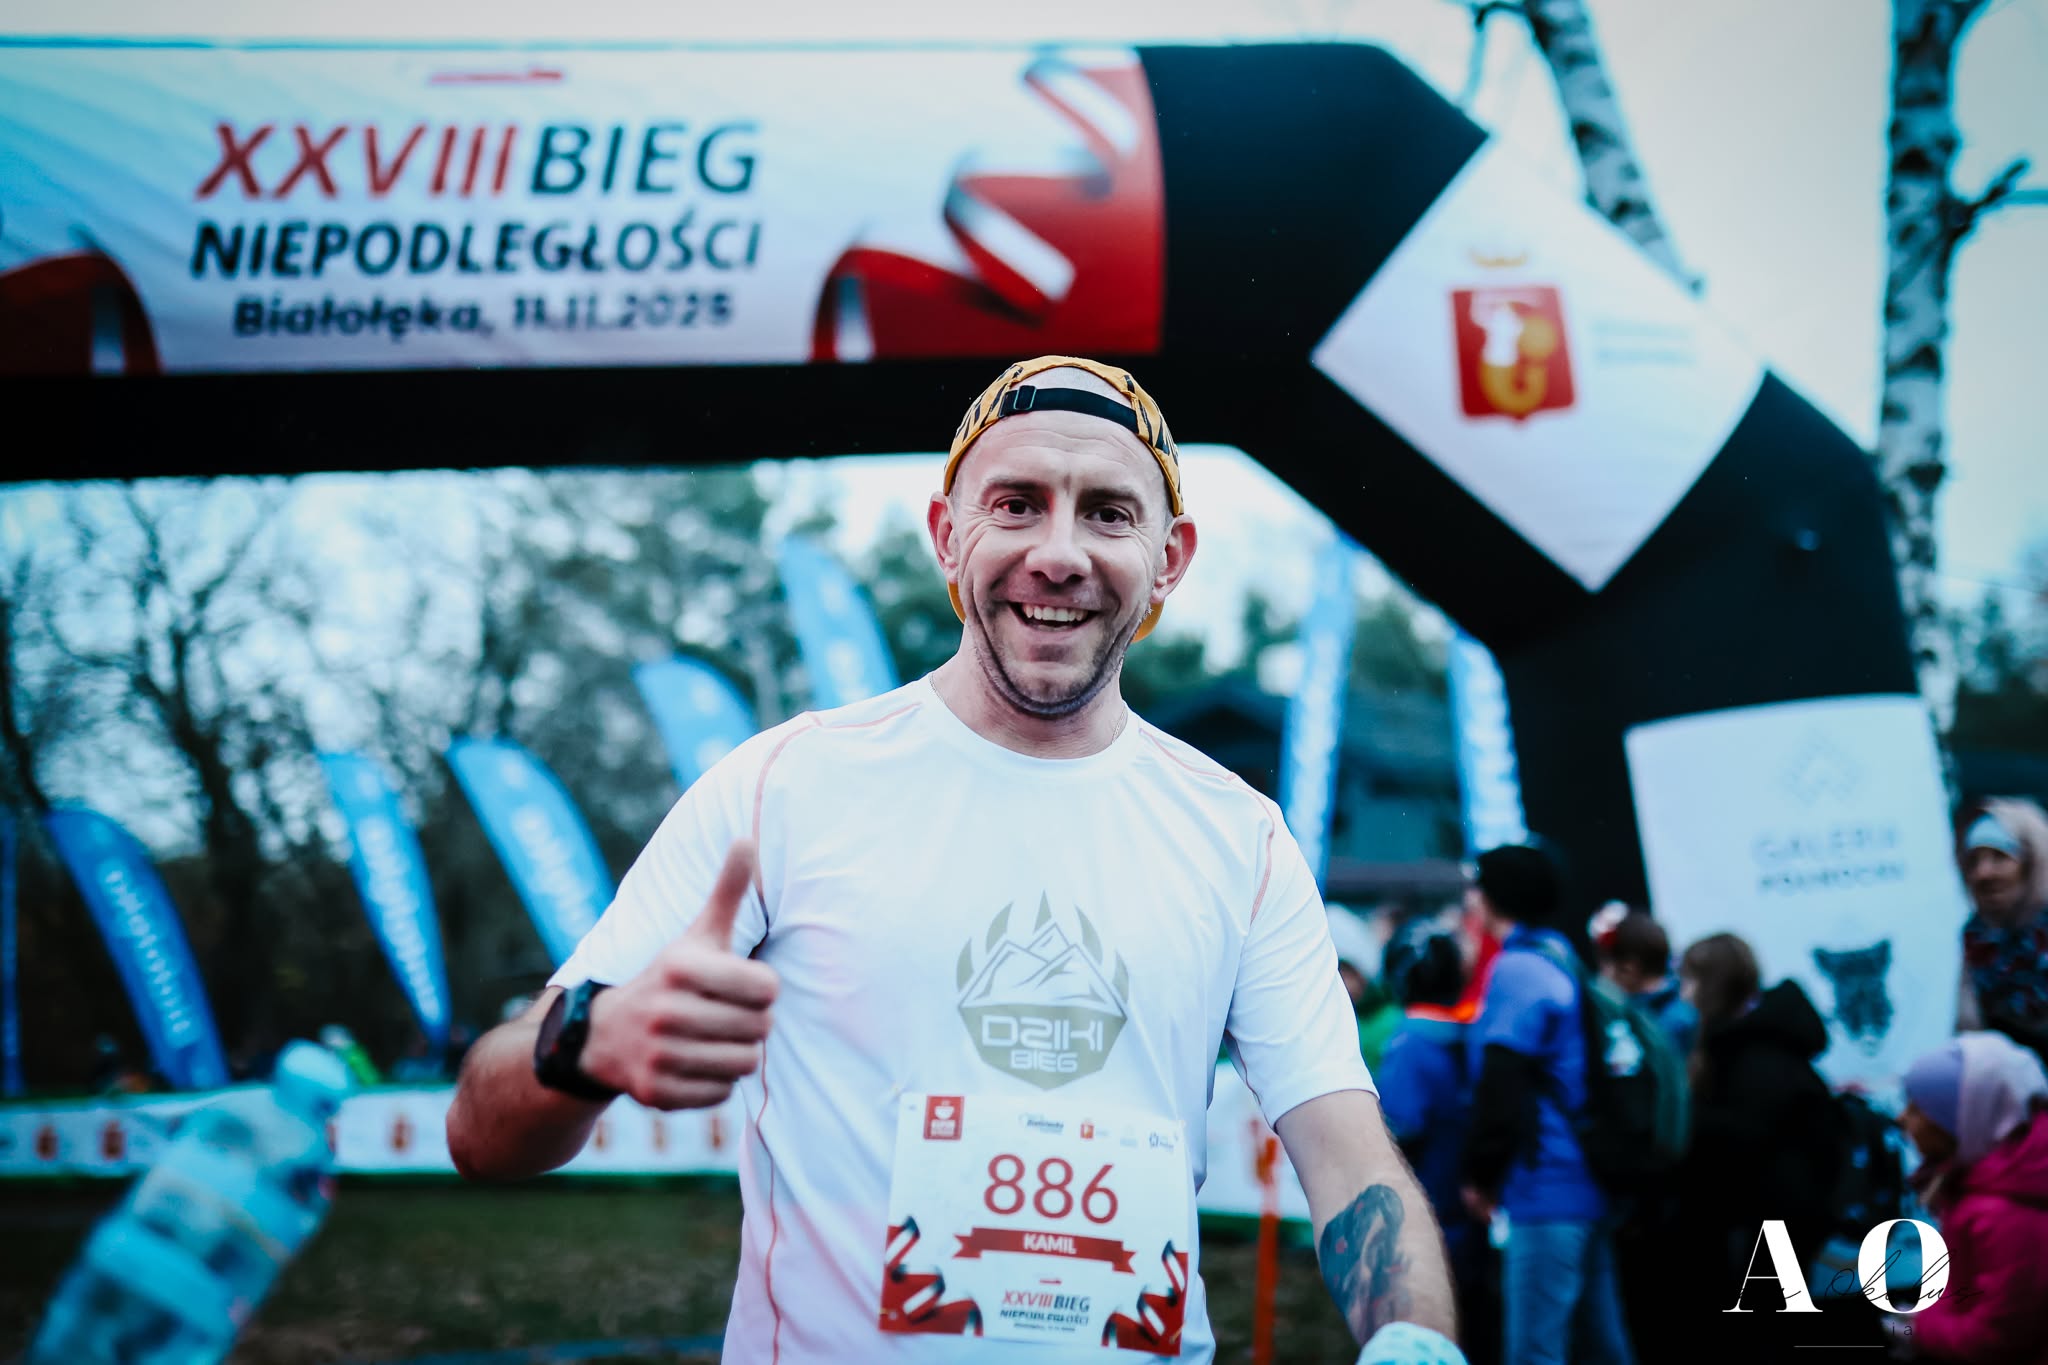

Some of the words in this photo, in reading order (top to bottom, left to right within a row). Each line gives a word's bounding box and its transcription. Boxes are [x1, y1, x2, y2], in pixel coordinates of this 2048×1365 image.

[529, 121, 760, 195] BIEG
[191, 208, 762, 279] NIEPODLEGŁOŚCI
[981, 1014, 1104, 1051] DZIKI
[1010, 1050, 1078, 1073] BIEG
[984, 1154, 1119, 1224] 886
[1023, 1233, 1077, 1255] KAMIL
